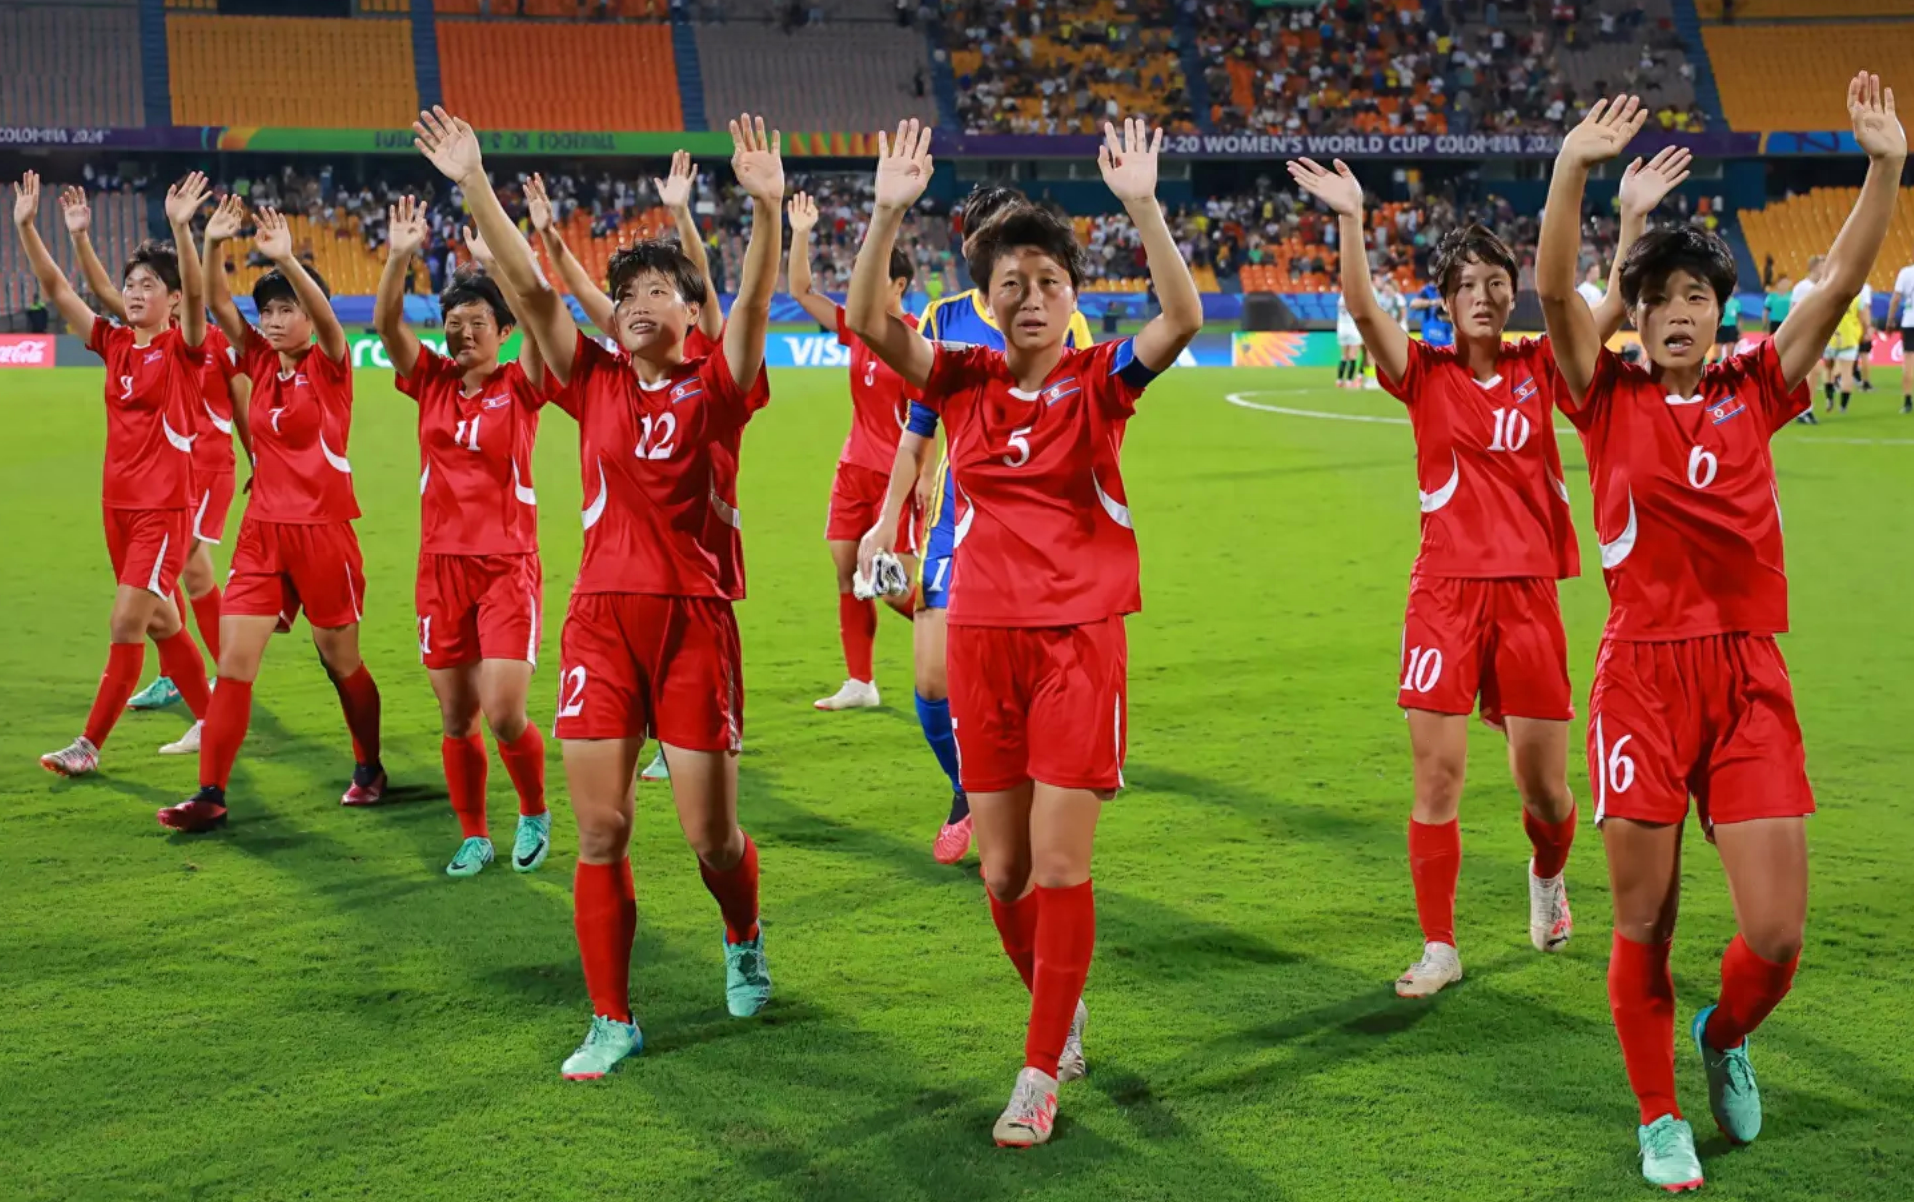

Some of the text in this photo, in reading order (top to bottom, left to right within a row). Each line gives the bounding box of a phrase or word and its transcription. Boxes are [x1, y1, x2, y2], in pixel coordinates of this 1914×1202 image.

[1204, 135, 1302, 153] WOMEN'S
[1306, 135, 1384, 153] WORLD
[1388, 135, 1431, 153] CUP
[120, 375, 134, 400] 9
[863, 361, 877, 387] 3
[269, 405, 288, 432] 7
[454, 413, 482, 451] 11
[634, 411, 676, 460] 12
[1486, 407, 1530, 451] 10
[1002, 426, 1031, 467] 5
[1687, 445, 1718, 489] 6
[927, 557, 950, 591] 1
[1401, 645, 1443, 693] 10
[557, 665, 587, 717] 12
[1608, 734, 1635, 793] 6
